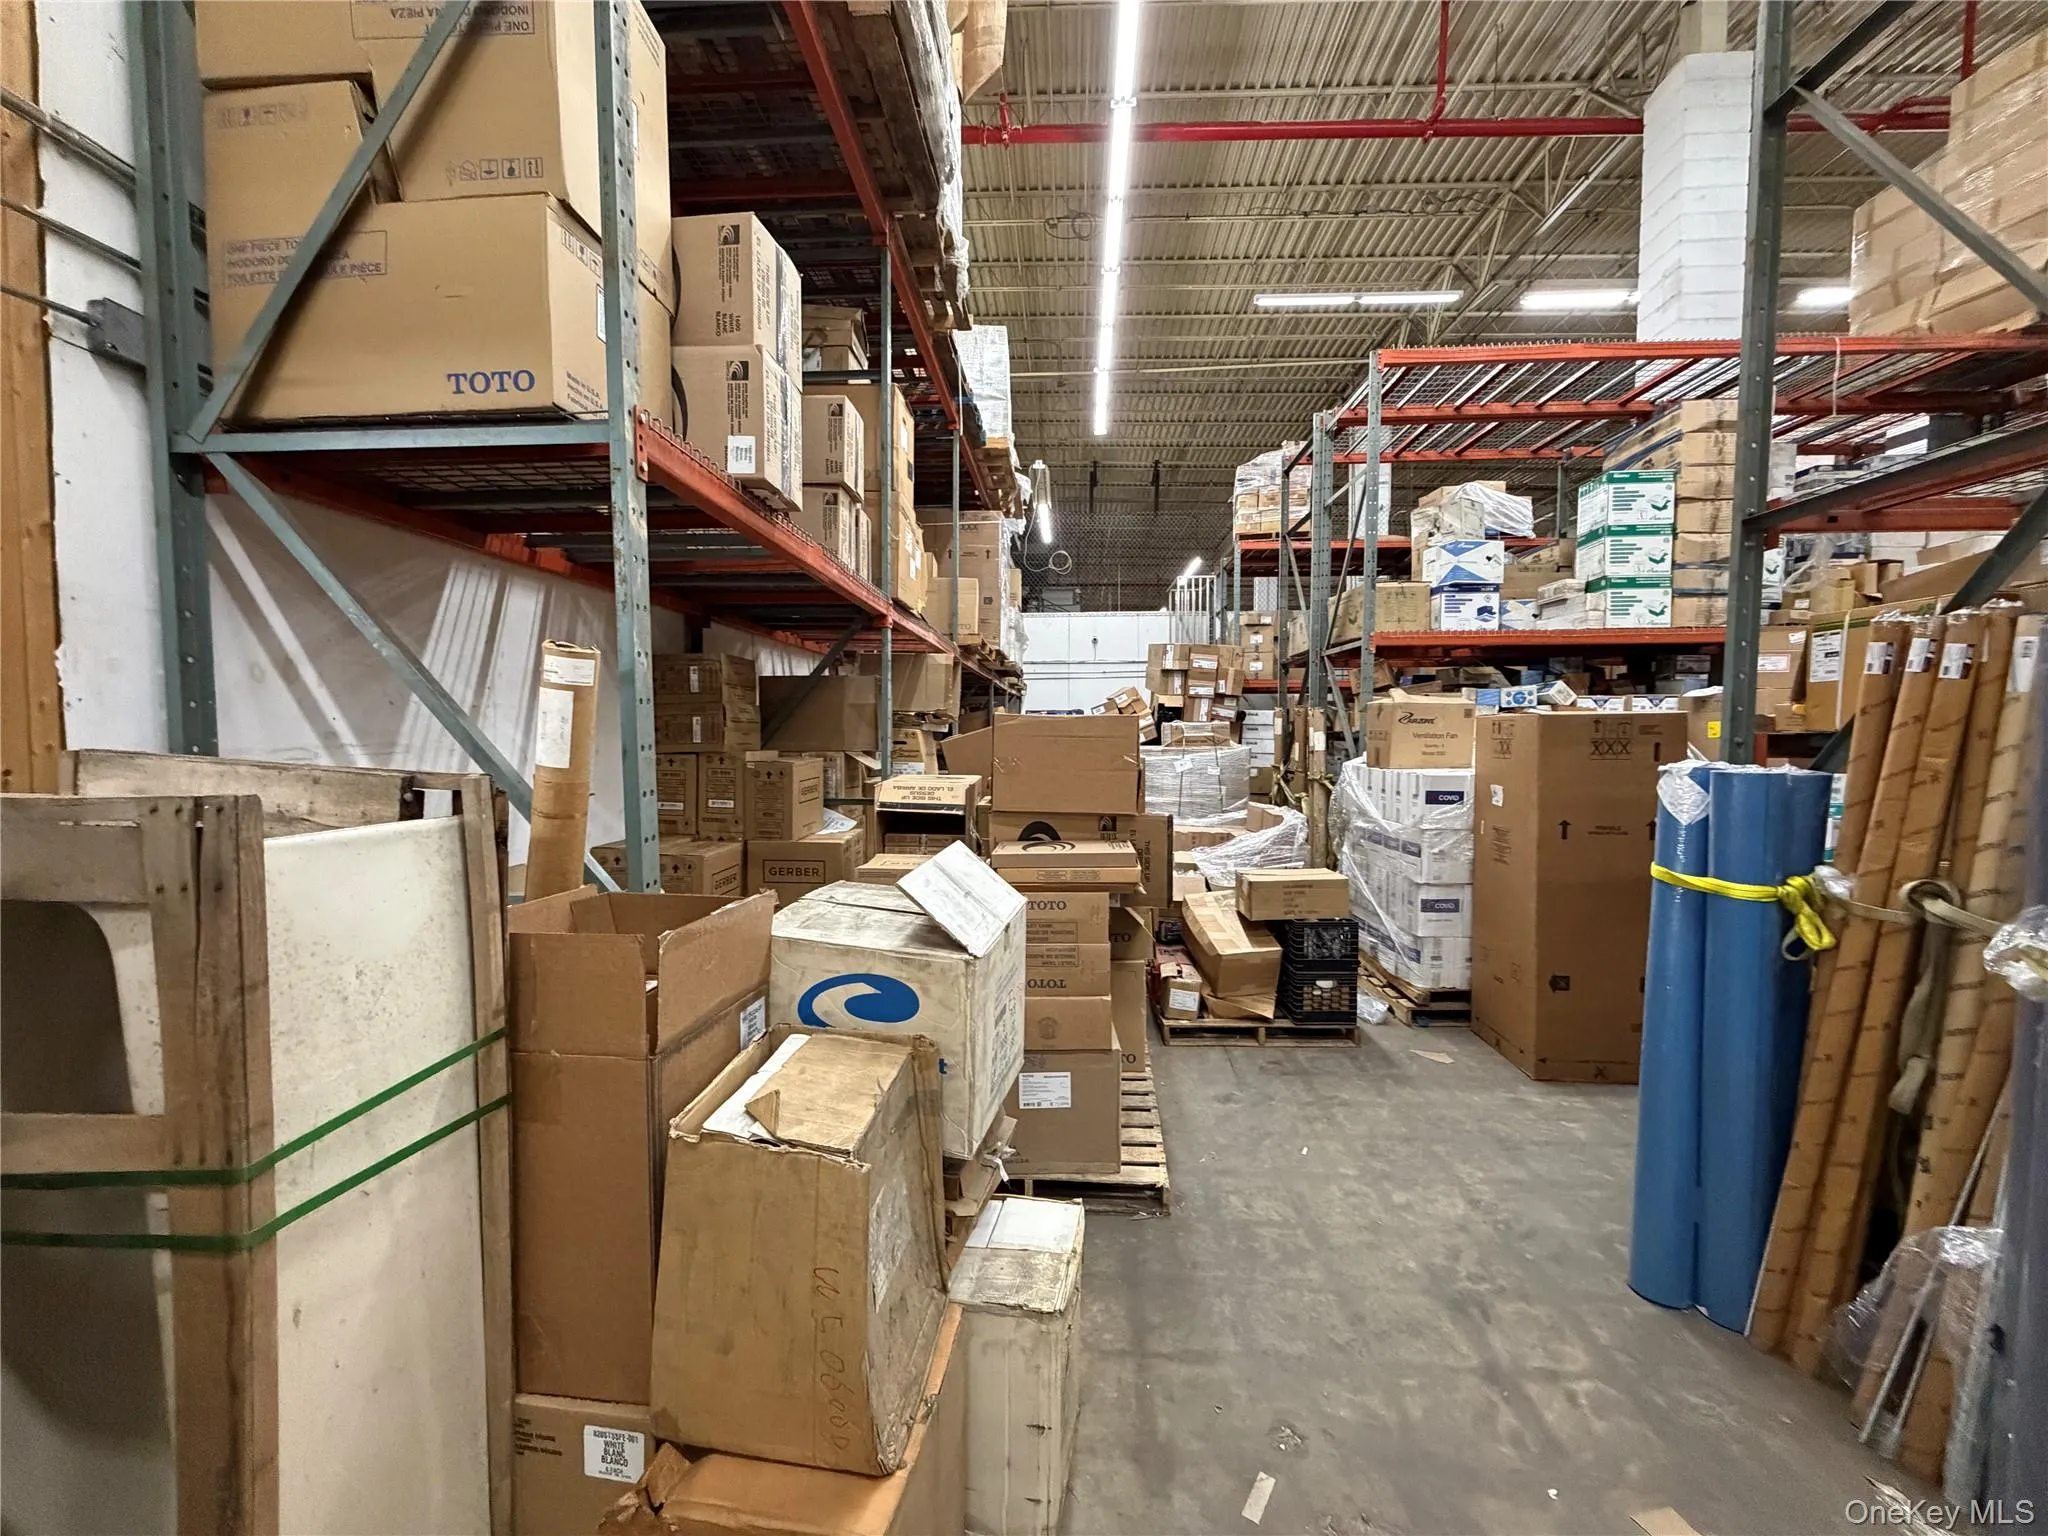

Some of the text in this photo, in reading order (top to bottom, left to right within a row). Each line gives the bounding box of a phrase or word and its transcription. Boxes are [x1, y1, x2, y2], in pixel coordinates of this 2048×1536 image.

[446, 369, 536, 395] TOTO
[1445, 731, 1458, 739] Fan
[768, 866, 820, 877] GERBER
[1027, 900, 1067, 910] TOTO
[1027, 978, 1067, 989] TOTO
[603, 1440, 625, 1450] WHITE
[603, 1448, 626, 1459] BLANC
[601, 1455, 629, 1468] BLANCO
